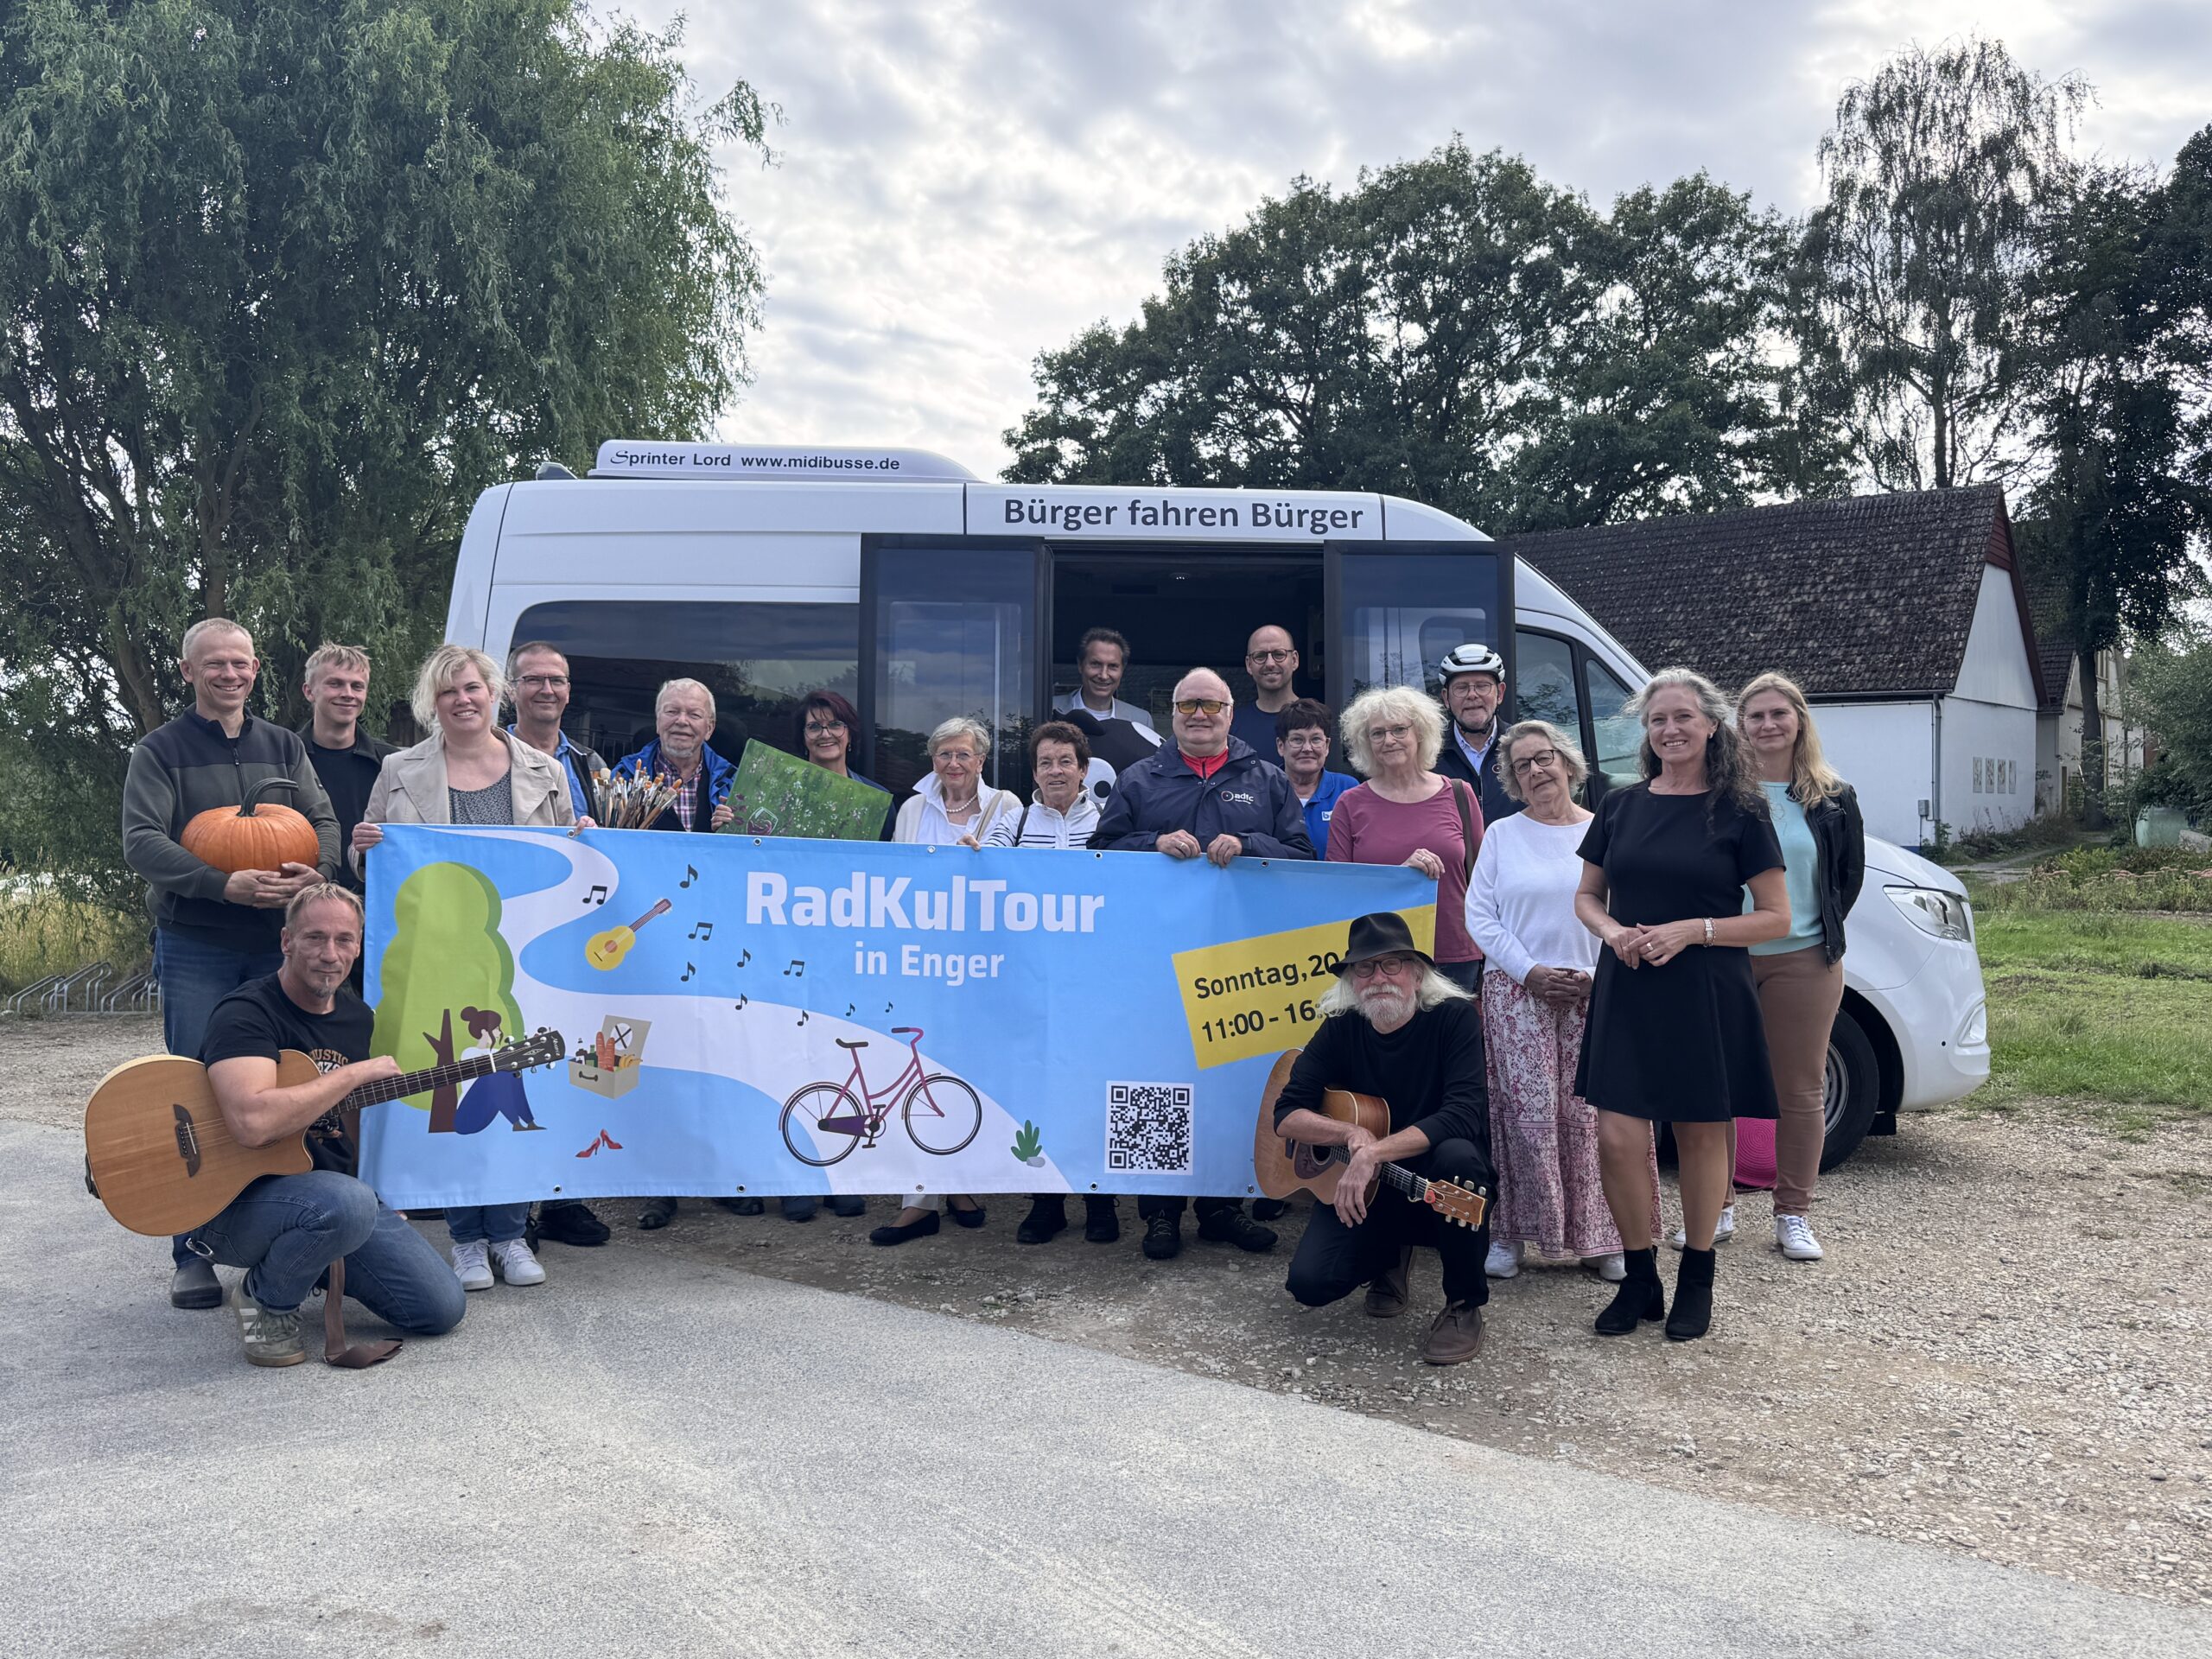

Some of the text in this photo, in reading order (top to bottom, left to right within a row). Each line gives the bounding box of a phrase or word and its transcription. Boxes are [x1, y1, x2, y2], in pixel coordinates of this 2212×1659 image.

[610, 449, 901, 471] Sprinter Lord www.midibusse.de
[1004, 498, 1364, 535] Bürger fahren Bürger
[746, 870, 1105, 933] RadKulTour
[855, 940, 1006, 987] in Enger
[1201, 1009, 1265, 1043] 11:00
[1284, 999, 1324, 1026] 16:
